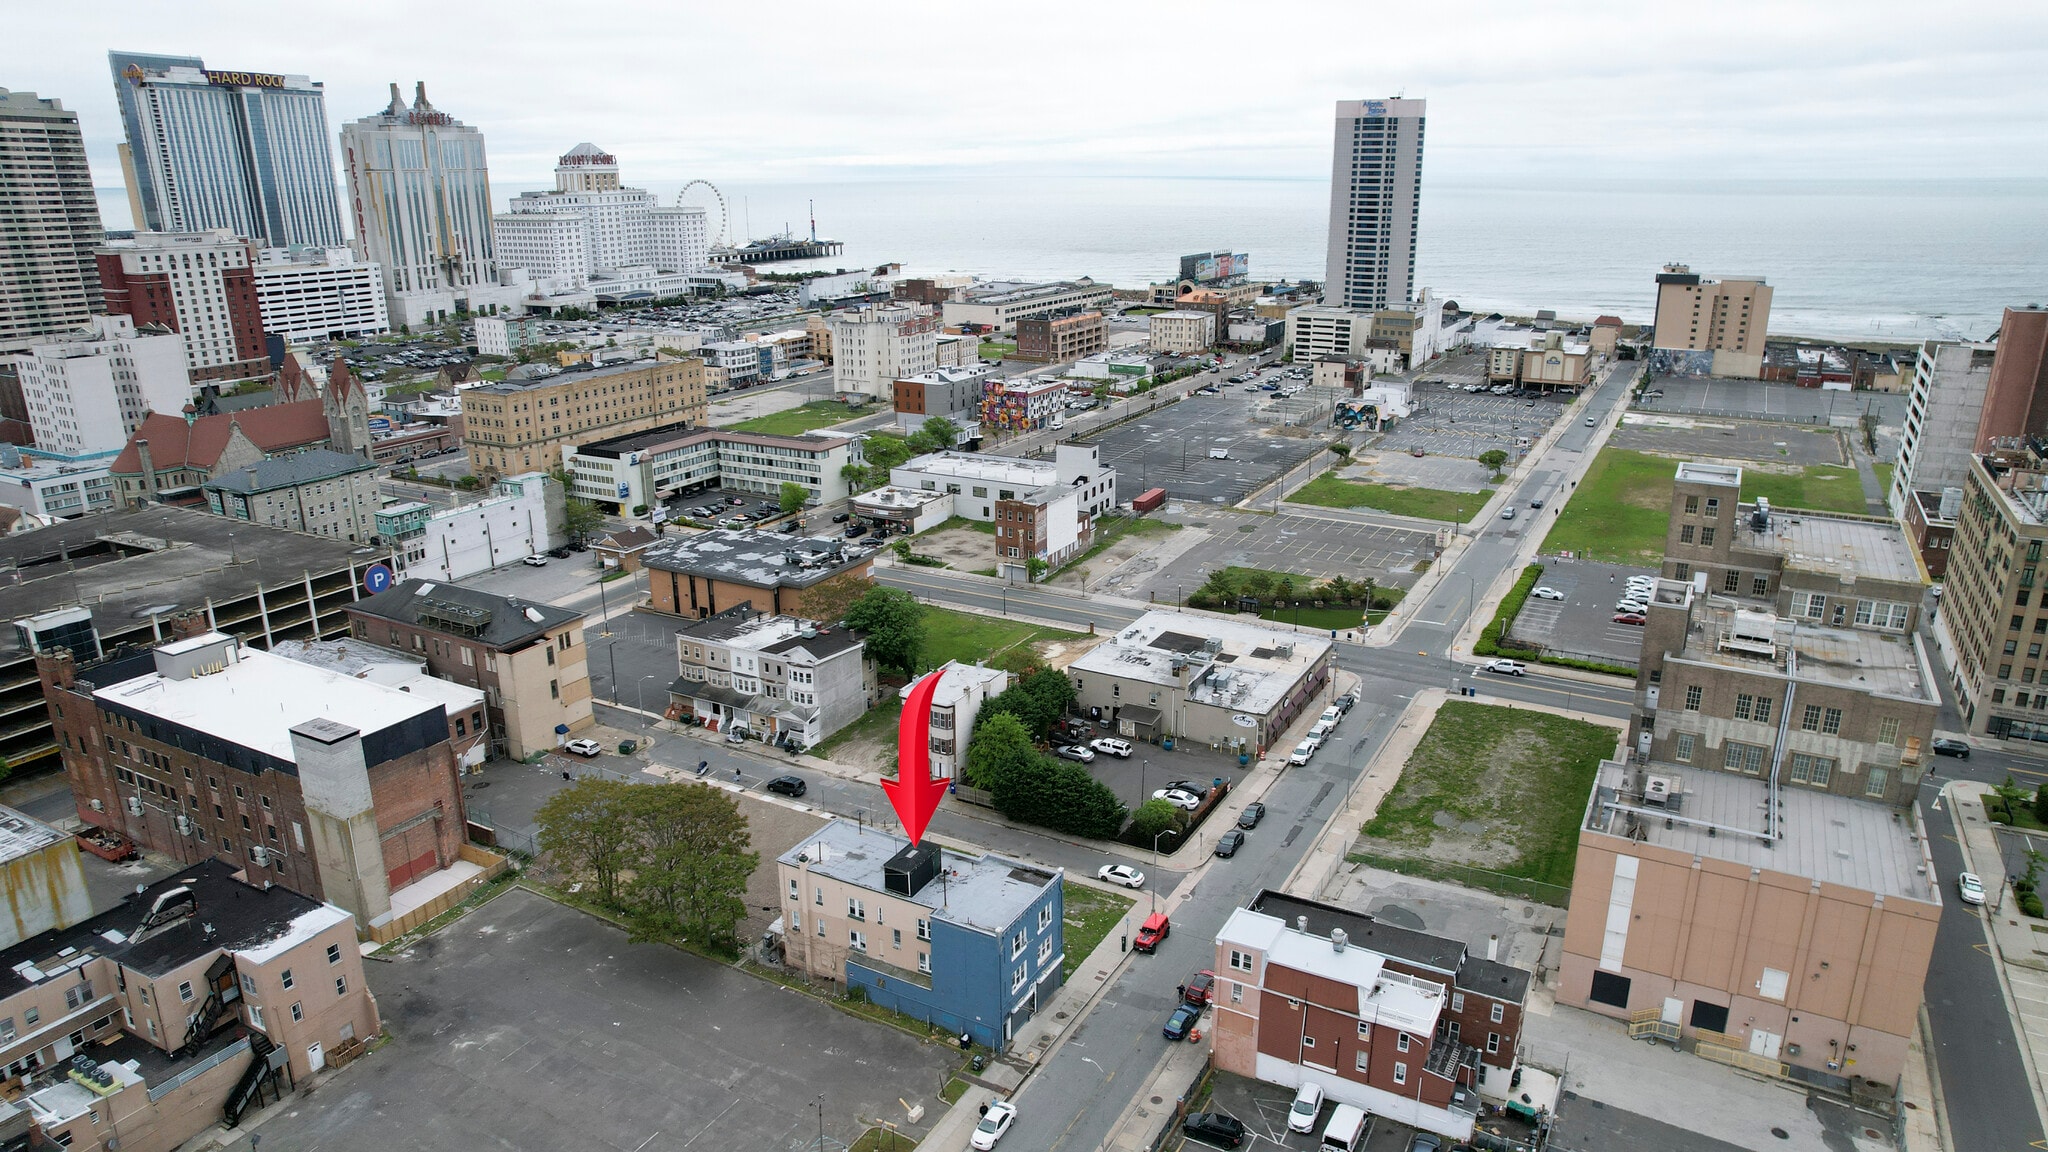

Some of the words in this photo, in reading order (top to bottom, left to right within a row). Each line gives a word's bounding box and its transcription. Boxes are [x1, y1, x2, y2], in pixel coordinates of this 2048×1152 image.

[208, 71, 251, 85] HARD
[254, 73, 285, 88] ROCK
[409, 111, 454, 126] RESORTS
[559, 155, 590, 166] RESORTS
[591, 154, 617, 165] RESORTS
[348, 147, 369, 261] RESORTS
[374, 572, 384, 588] P
